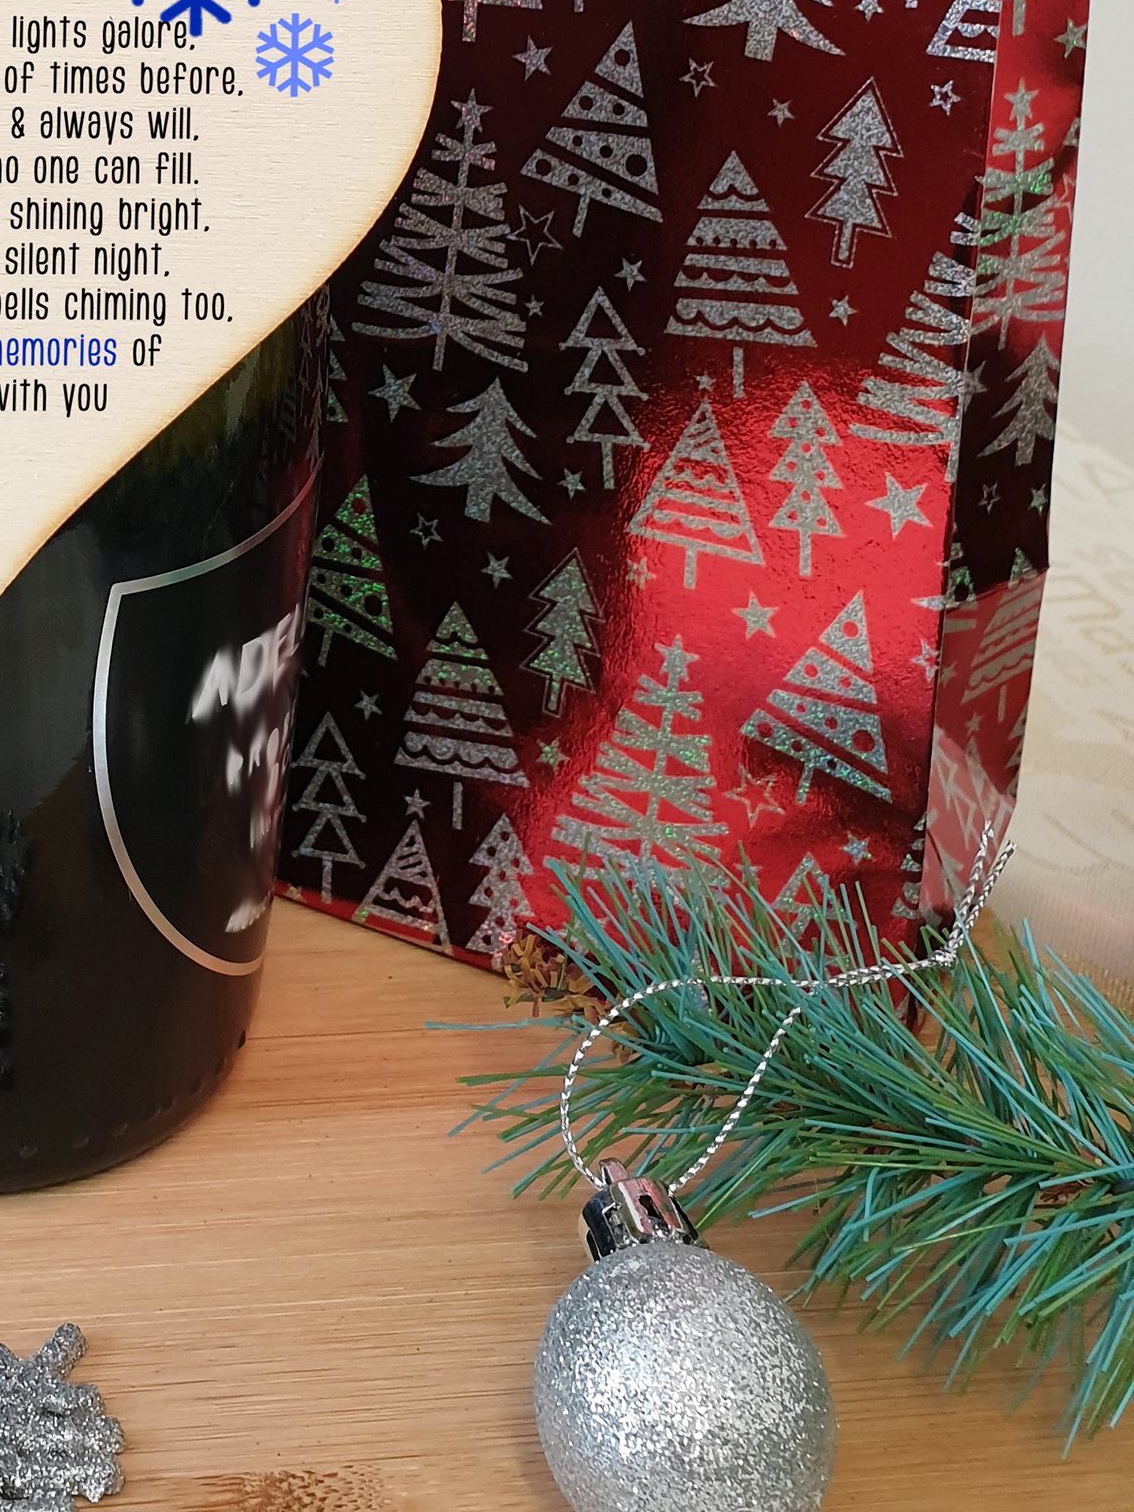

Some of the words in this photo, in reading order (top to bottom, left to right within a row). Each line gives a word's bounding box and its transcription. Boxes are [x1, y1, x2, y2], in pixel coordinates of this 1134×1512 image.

[12, 15, 87, 54] lights
[102, 16, 195, 55] galore,
[4, 61, 35, 94] of
[49, 61, 126, 94] times
[140, 61, 244, 97] before,
[11, 106, 25, 139] &
[40, 106, 133, 146] always
[147, 106, 199, 141] will,
[33, 155, 79, 184] one
[94, 155, 140, 185] can
[155, 151, 199, 185] fill.
[10, 197, 103, 236] shining
[119, 197, 210, 237] bright,
[5, 242, 80, 275] silent
[94, 242, 170, 282] night,
[64, 287, 166, 327] chiming
[181, 288, 233, 323] too,
[132, 333, 162, 367] of
[62, 383, 108, 418] you
